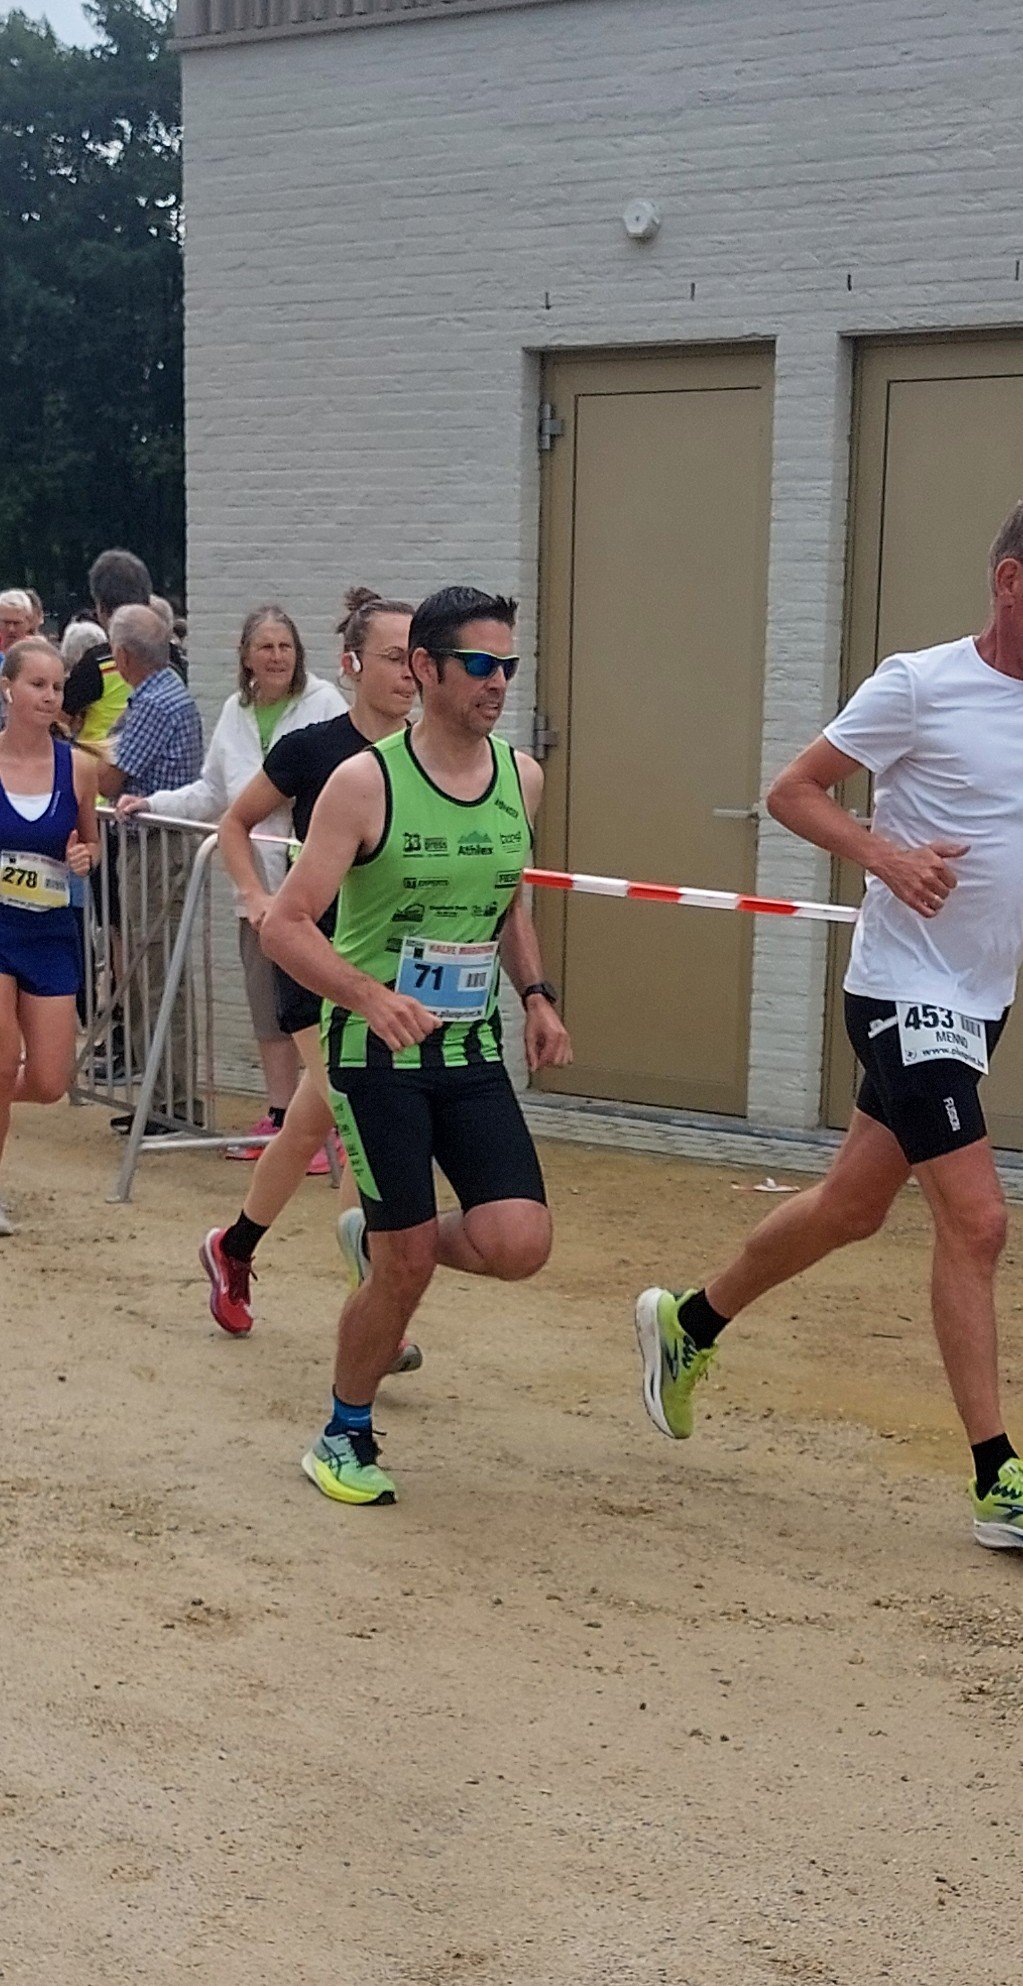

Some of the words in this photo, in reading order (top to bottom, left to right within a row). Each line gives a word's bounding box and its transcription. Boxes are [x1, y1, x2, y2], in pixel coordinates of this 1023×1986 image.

[2, 866, 38, 889] 278
[414, 963, 444, 990] 71
[904, 1003, 955, 1031] 453
